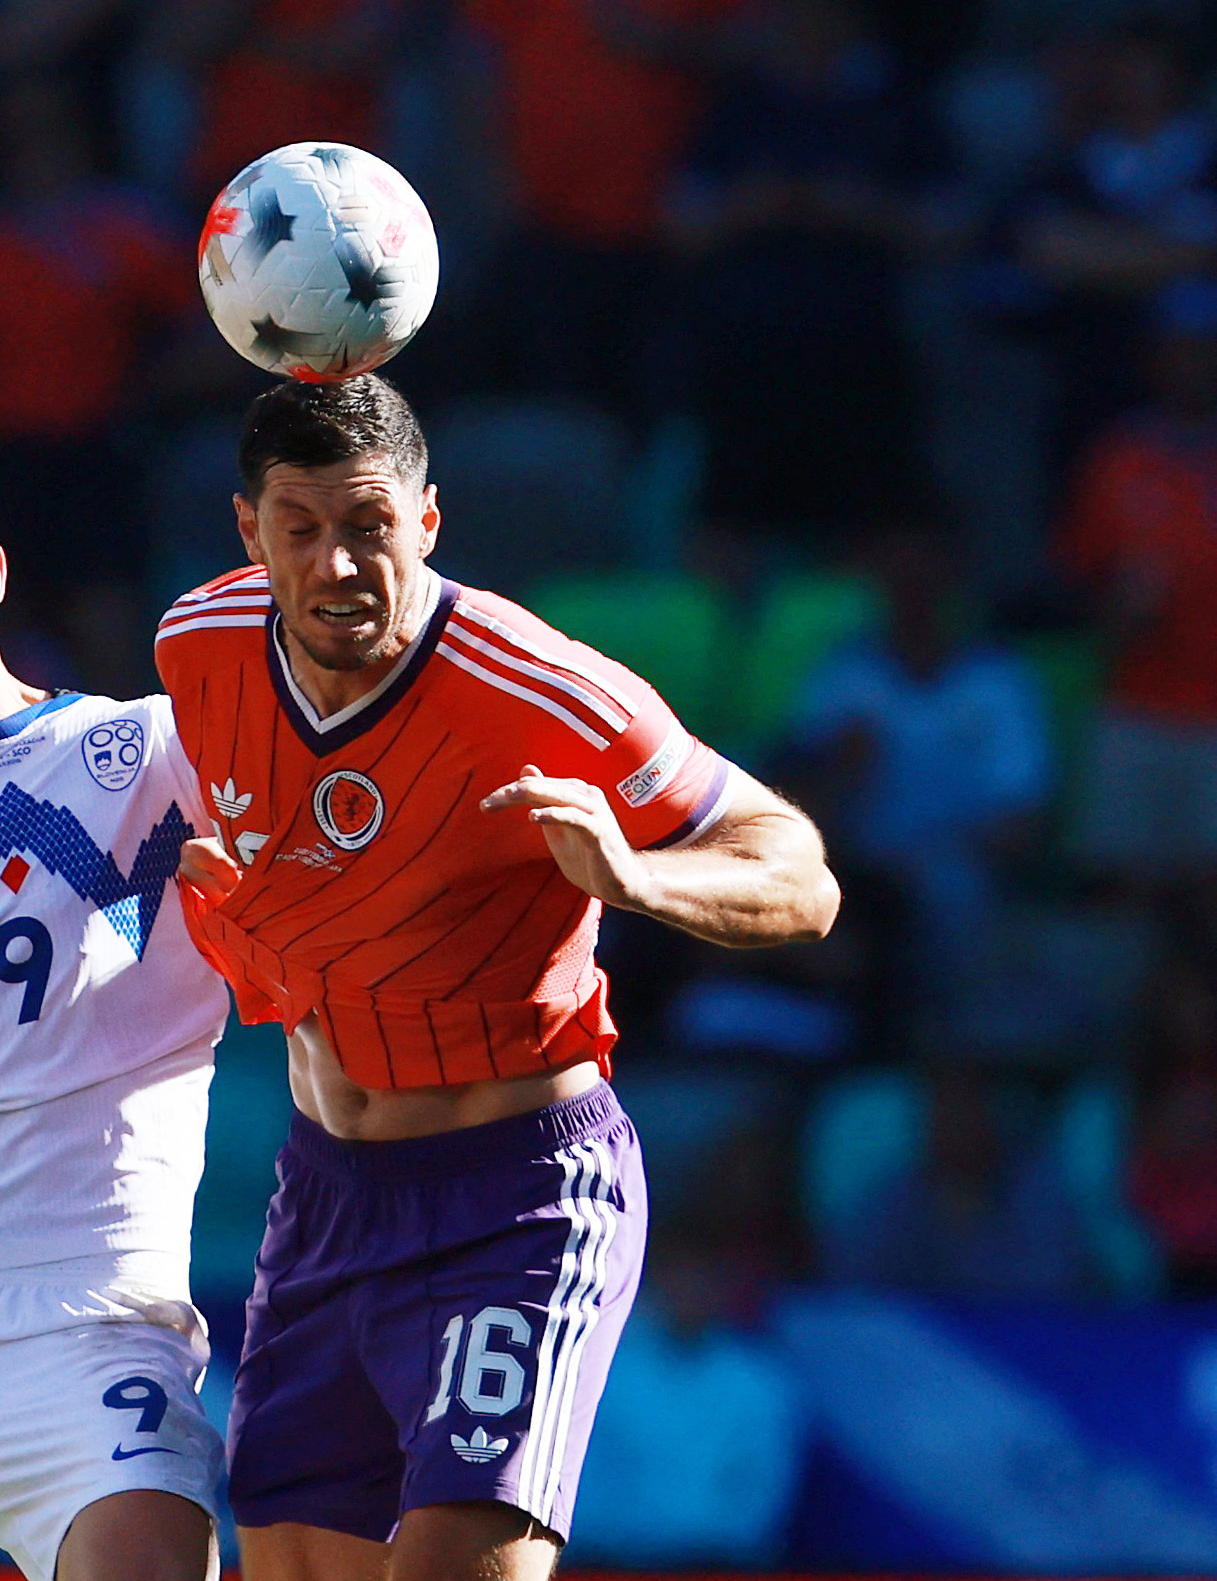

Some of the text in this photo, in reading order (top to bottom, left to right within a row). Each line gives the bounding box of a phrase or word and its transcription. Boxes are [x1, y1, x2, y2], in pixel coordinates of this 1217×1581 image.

[12, 746, 31, 757] SCO
[619, 774, 640, 792] UEFA
[423, 1306, 532, 1427] 16
[102, 1376, 169, 1433] 9
